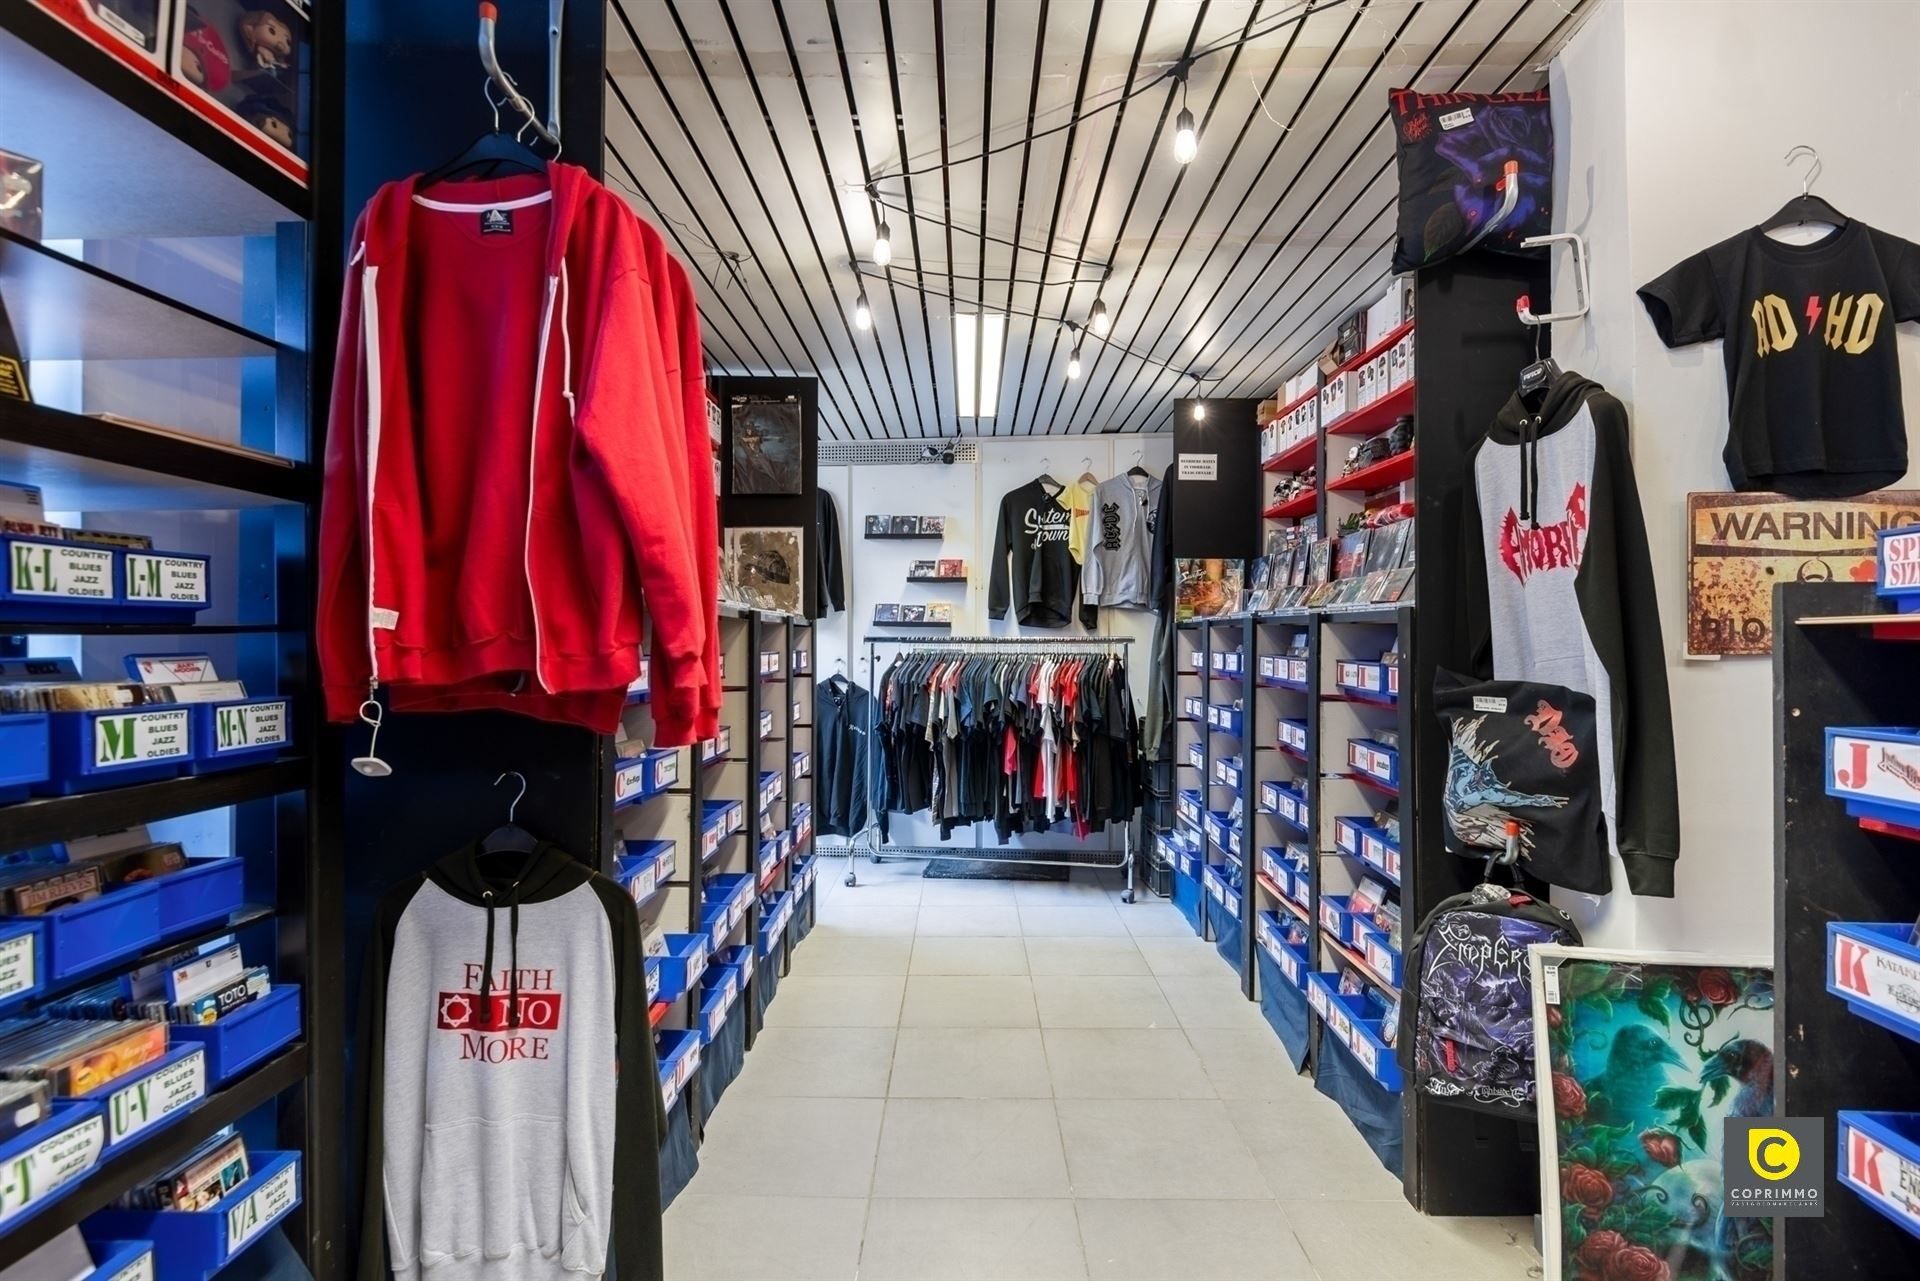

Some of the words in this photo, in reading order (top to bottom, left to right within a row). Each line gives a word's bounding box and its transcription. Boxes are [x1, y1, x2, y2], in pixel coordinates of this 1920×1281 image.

[1752, 294, 1798, 358] AD
[1824, 292, 1884, 355] HD
[61, 549, 110, 561] COUNTRY
[1889, 536, 1920, 562] SP
[15, 545, 58, 592] K-L
[69, 562, 102, 572] BLUES
[165, 559, 204, 569] COUNTRY
[171, 570, 198, 580] BLUES
[1889, 562, 1920, 586] SIZ
[73, 575, 99, 584] JAZZ
[129, 557, 163, 598] L-M
[175, 582, 195, 590] JAZZ
[68, 587, 105, 597] OLDIES
[170, 593, 200, 601] OLDIES
[1701, 617, 1766, 643] BIO
[141, 712, 185, 722] COUNTRY
[250, 703, 284, 713] COUNTRY
[255, 713, 279, 723] BLUES
[148, 724, 178, 734] BLUES
[218, 708, 248, 748] M-N
[255, 734, 280, 744] OLDIES
[258, 724, 276, 733] JAZZ
[100, 717, 137, 763] M
[152, 735, 175, 745] JAZZ
[147, 747, 180, 758] OLDIES
[1838, 742, 1871, 789] J
[462, 962, 555, 991] FAITH
[1840, 939, 1871, 997] K
[1876, 956, 1920, 981] KATAKL
[218, 984, 246, 1006] TOTO
[497, 997, 552, 1026] NO
[459, 1033, 549, 1064] MORE
[155, 1053, 201, 1081] COUNTRY
[163, 1067, 195, 1089] BLUES
[168, 1081, 193, 1099] JAZZ
[114, 1077, 152, 1136] U-V
[162, 1090, 197, 1113] OLDIES
[38, 1120, 99, 1154] COUNTRY
[51, 1138, 92, 1163] BLUES
[57, 1153, 88, 1175] JAZZ
[1852, 1131, 1885, 1196] K
[0, 1153, 36, 1210] -T
[266, 1178, 289, 1199] BLUES
[1900, 1169, 1920, 1199] EN
[269, 1190, 287, 1208] JAZZ
[231, 1193, 257, 1241] V/A
